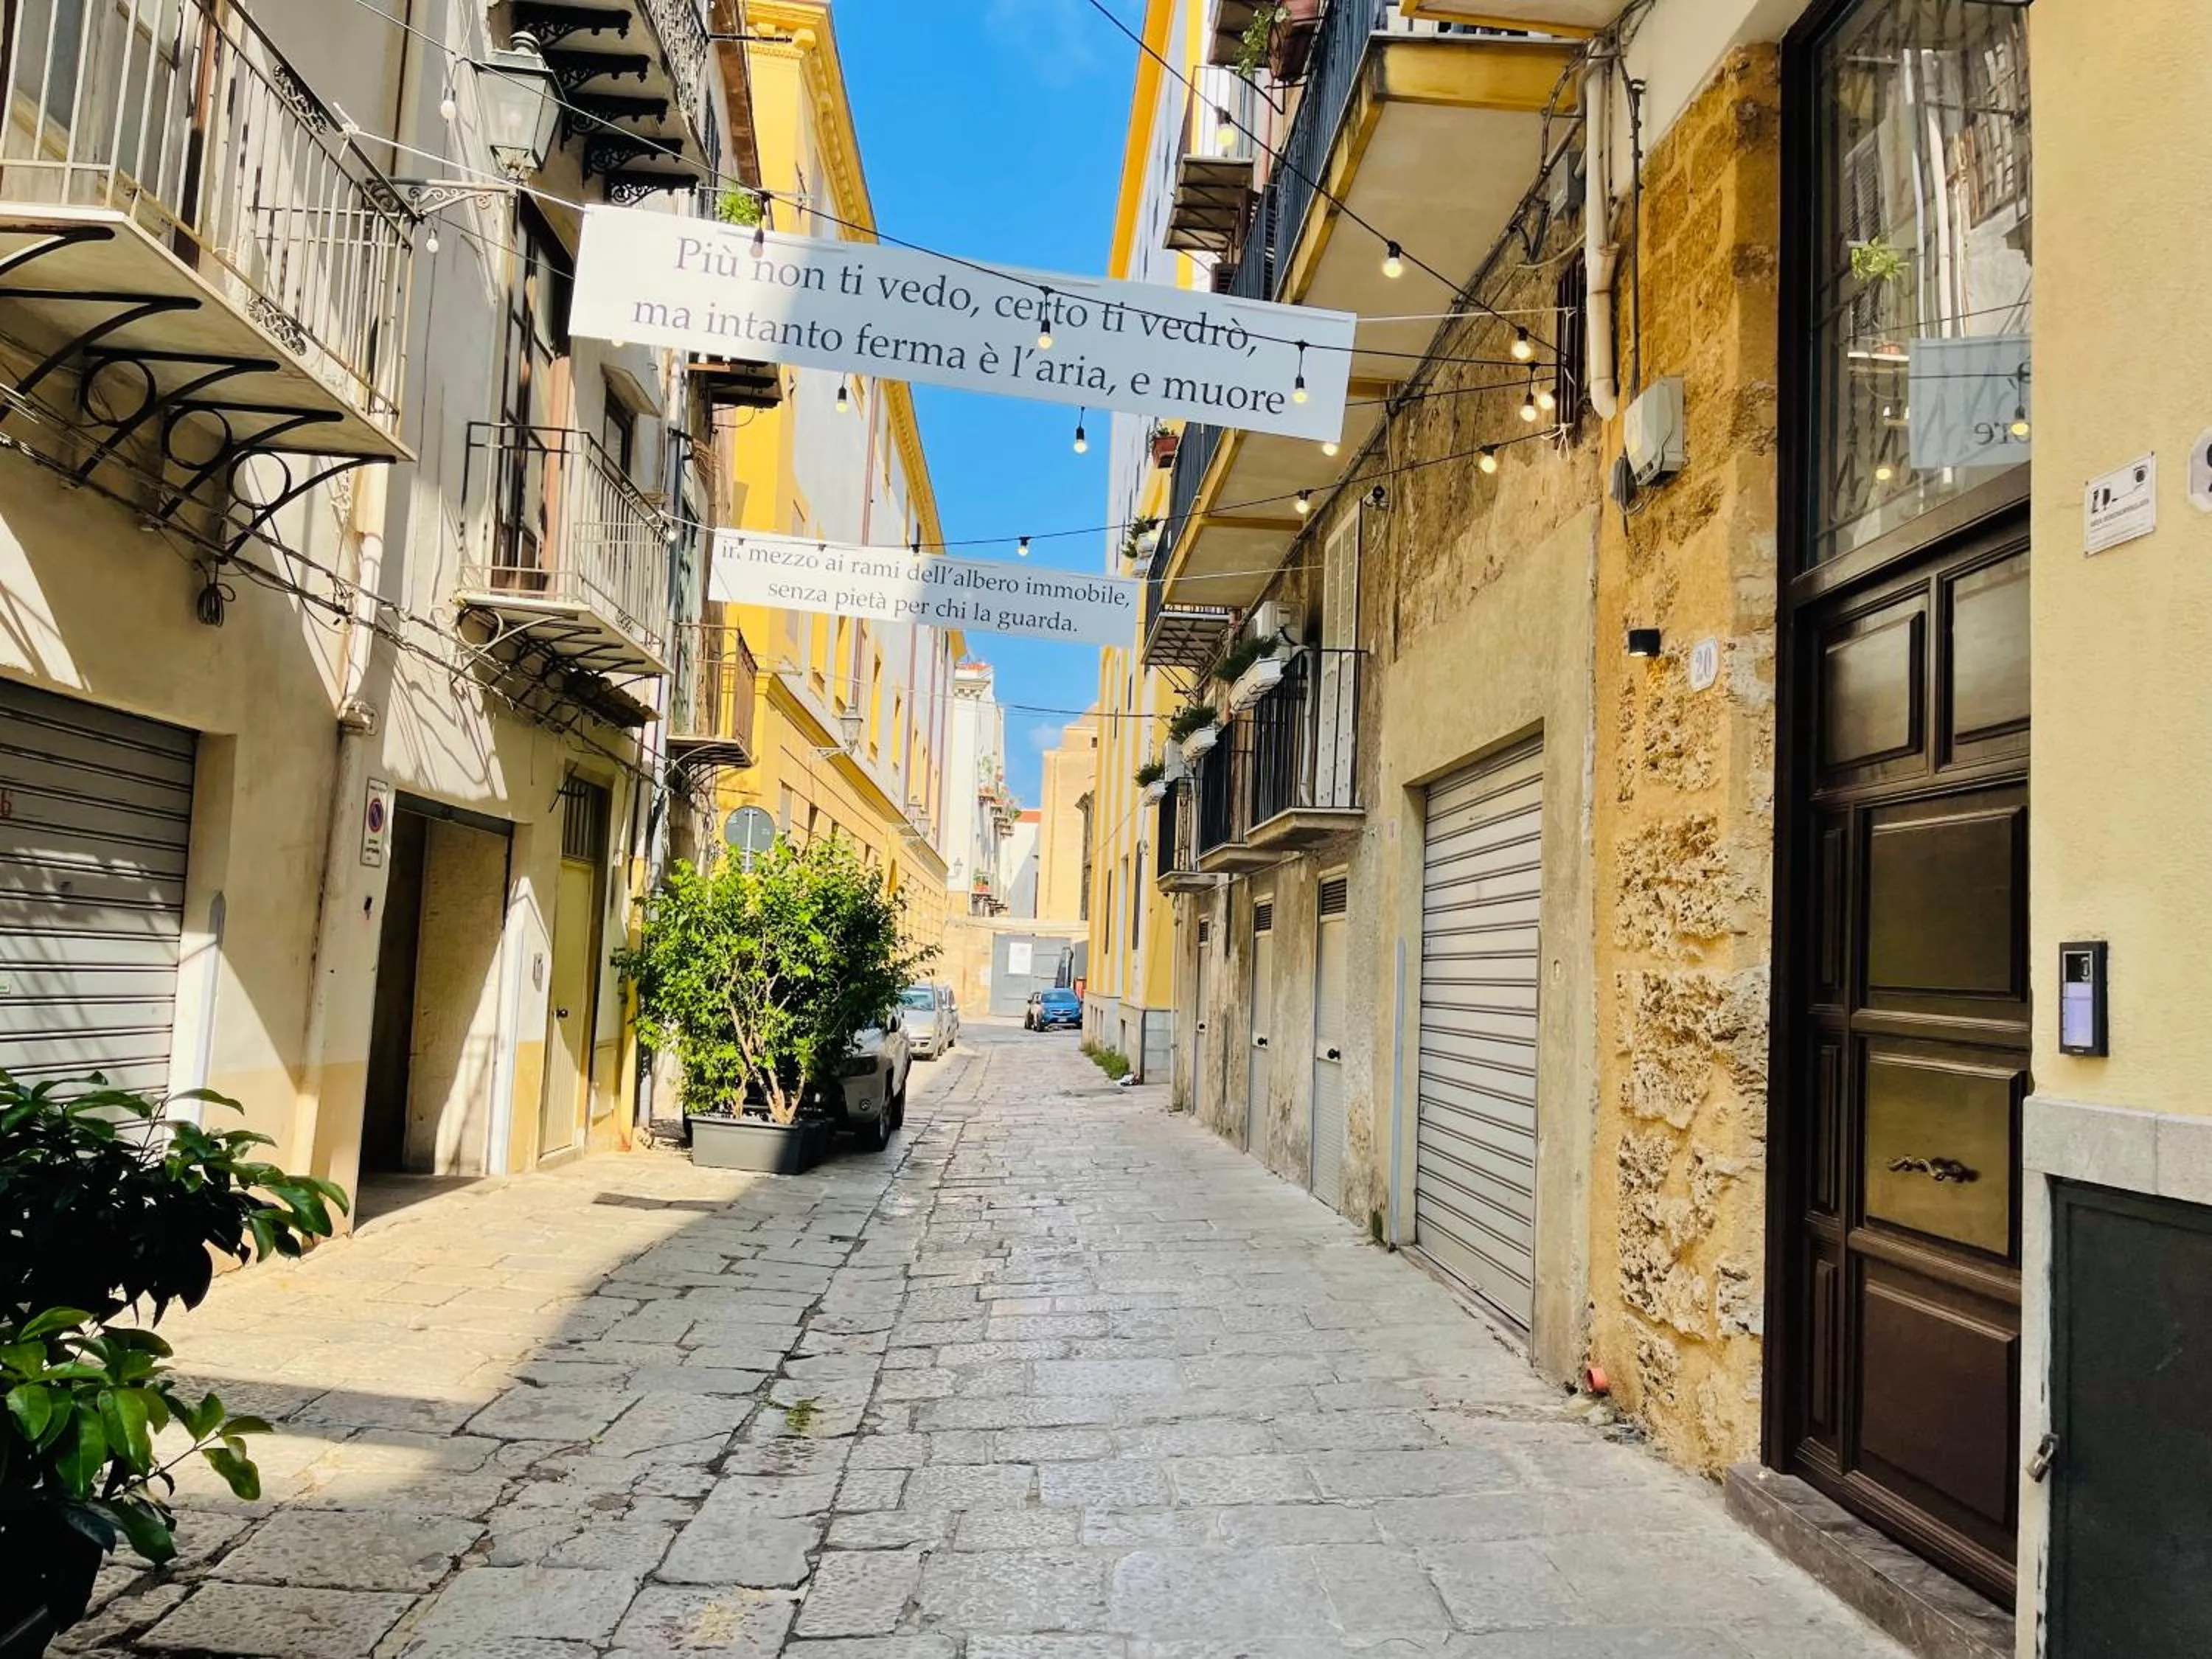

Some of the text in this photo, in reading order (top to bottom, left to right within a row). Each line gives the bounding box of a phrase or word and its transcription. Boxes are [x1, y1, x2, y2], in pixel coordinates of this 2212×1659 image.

[674, 236, 1258, 359] Più non ti vedo, certo ti vedrò,
[633, 299, 1285, 415] ma intanto ferma è l'aria, e muore
[748, 549, 819, 570] mezzo
[826, 556, 844, 572] ai
[851, 560, 900, 579] rami
[1026, 577, 1131, 608] immobile,
[768, 582, 1078, 633] senza pietà per chi la guarda.
